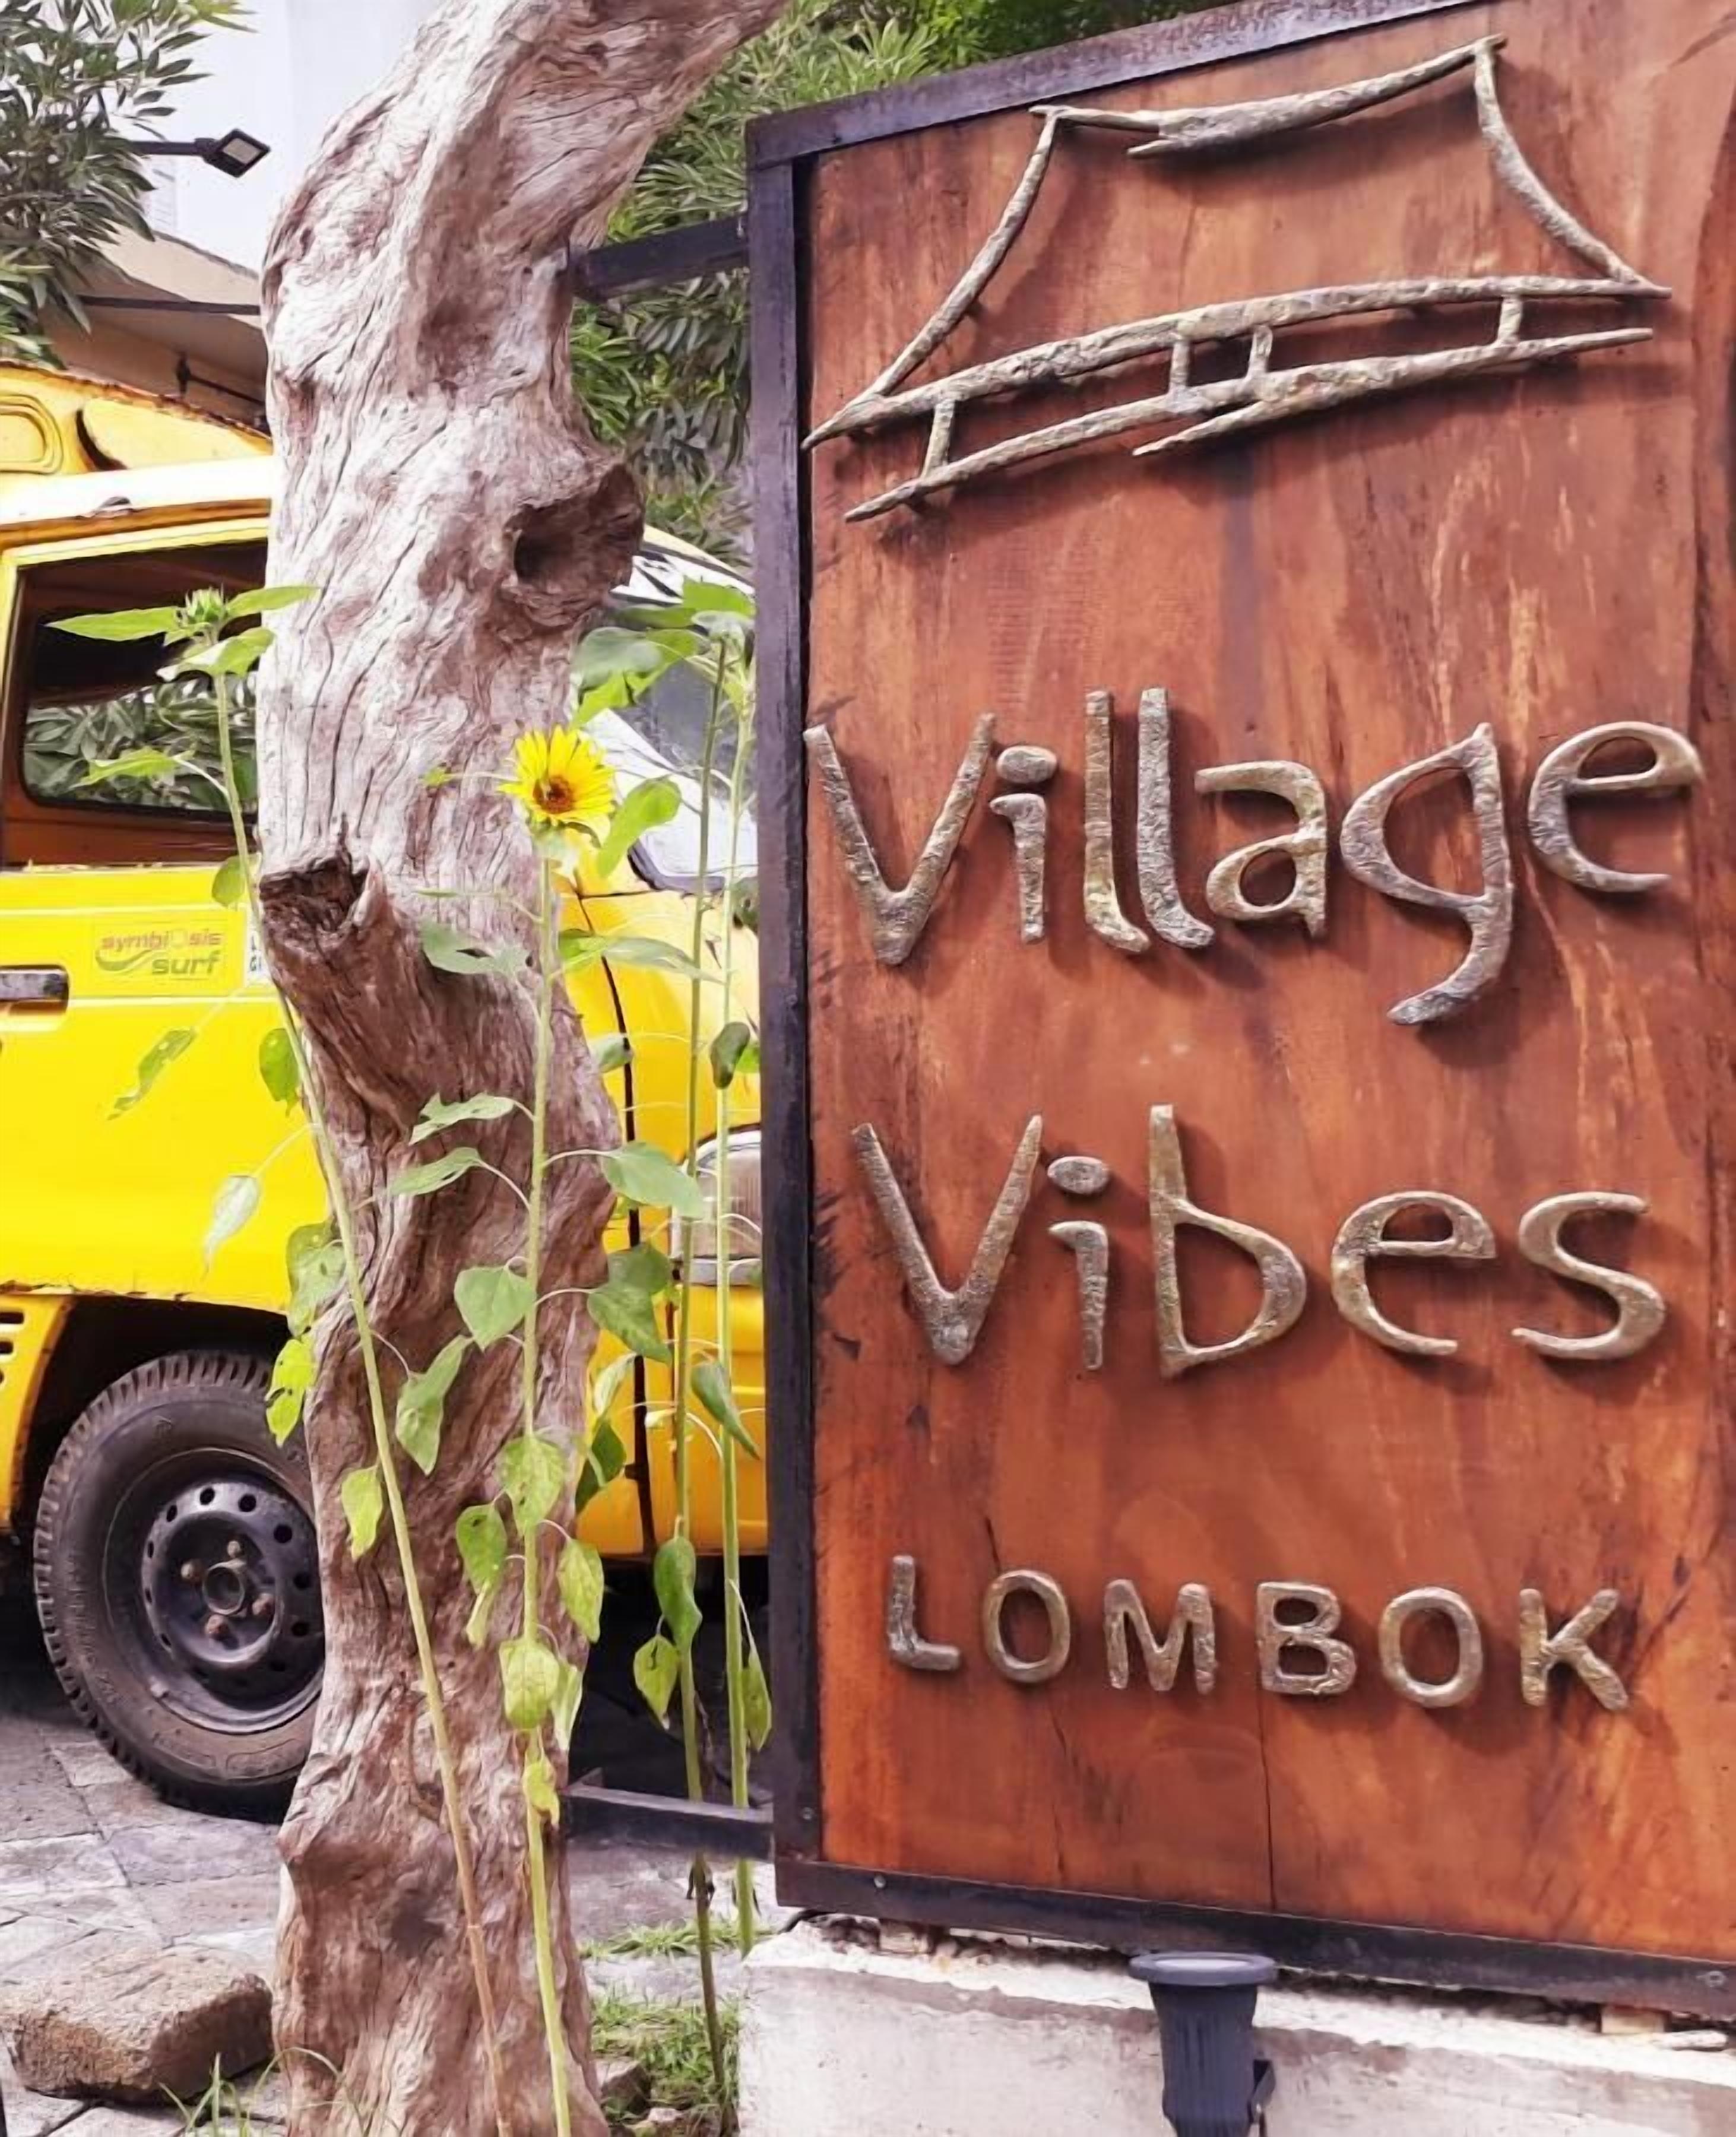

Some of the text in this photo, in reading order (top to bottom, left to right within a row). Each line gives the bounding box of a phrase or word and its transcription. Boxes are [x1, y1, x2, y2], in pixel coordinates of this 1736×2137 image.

[152, 949, 221, 974] surf
[803, 687, 1706, 1025] Village
[852, 1104, 1666, 1378] Vibes
[887, 1555, 1629, 1710] LOMBOK
